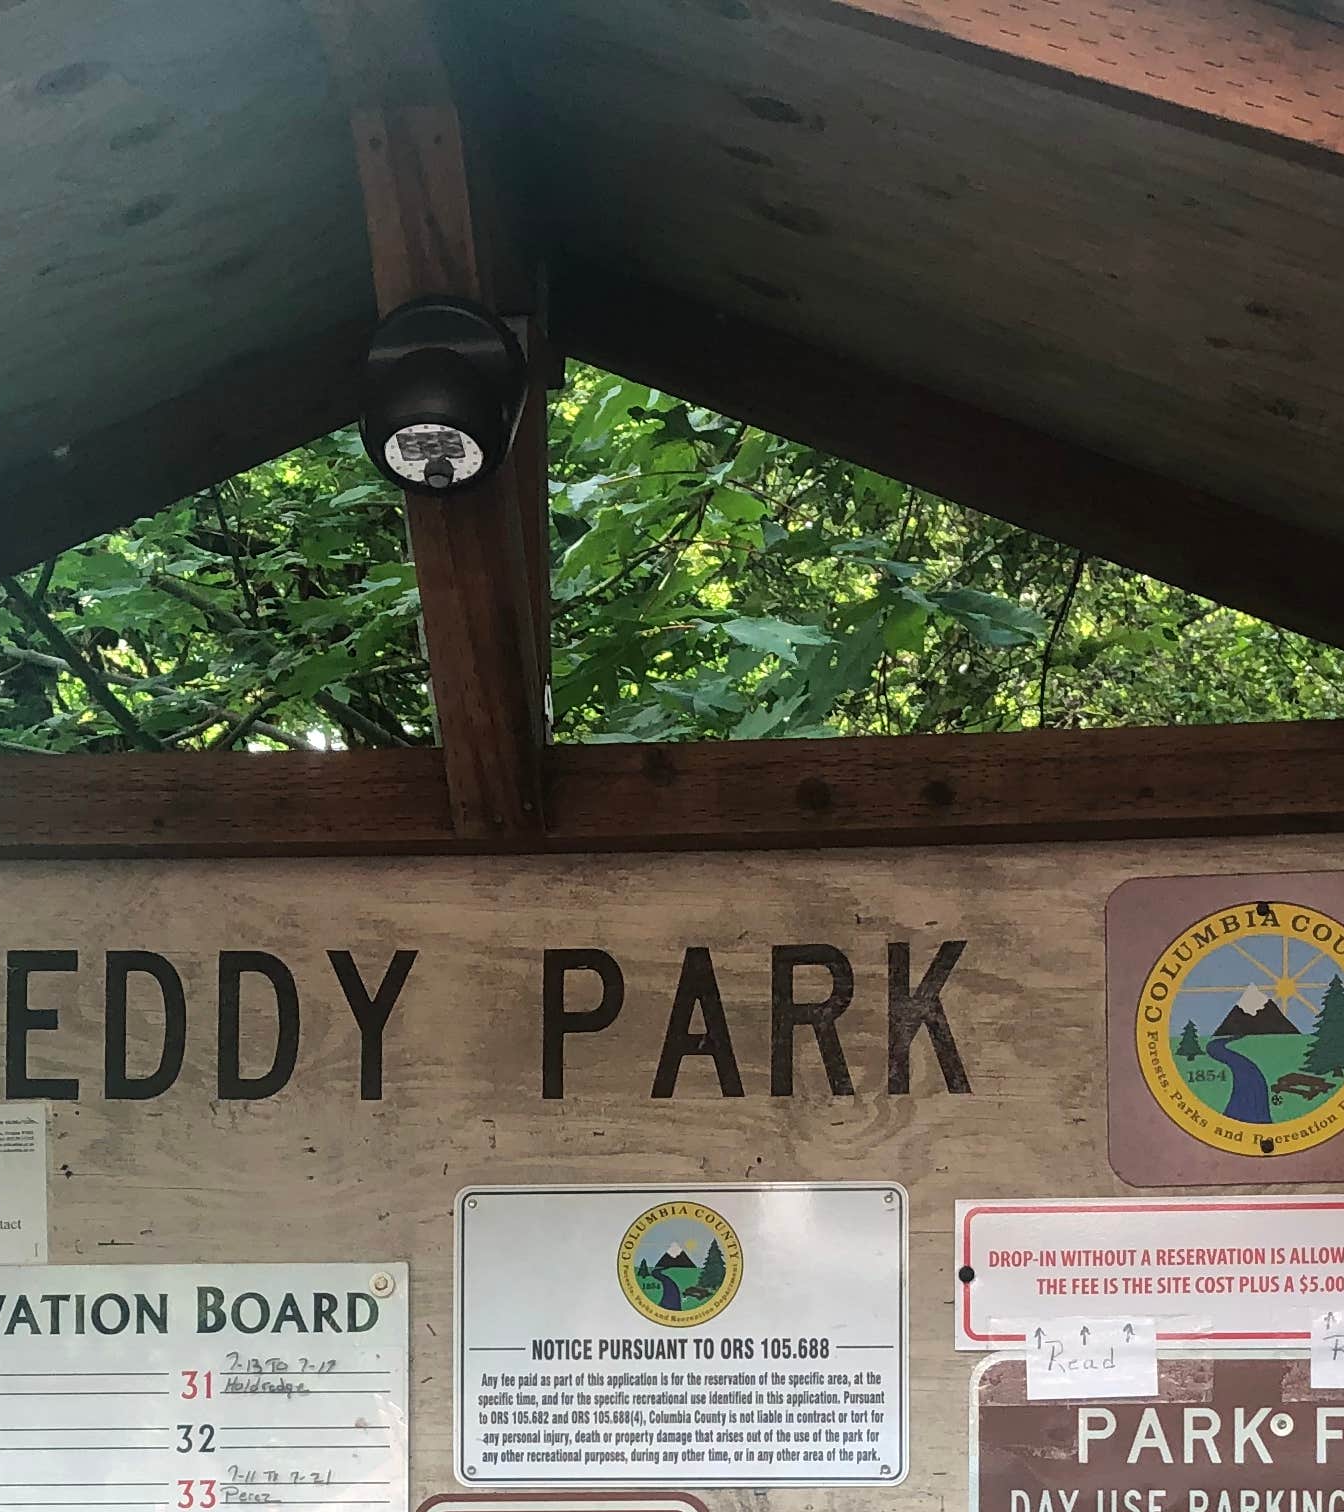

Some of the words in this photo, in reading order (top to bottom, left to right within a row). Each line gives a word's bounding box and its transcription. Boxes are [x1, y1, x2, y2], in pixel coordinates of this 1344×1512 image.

[1145, 910, 1280, 1024] COLUMBIA
[6, 949, 418, 1100] EDDY
[543, 940, 974, 1099] PARK
[1187, 1070, 1227, 1083] 1854
[1169, 1091, 1208, 1128] Parks
[1214, 1125, 1243, 1143] and
[989, 1250, 1057, 1268] DROP-IN
[1061, 1249, 1137, 1267] WITHOUT
[1141, 1249, 1152, 1266] A
[1157, 1247, 1265, 1266] RESERVATION
[1271, 1247, 1285, 1265] IS
[1037, 1277, 1067, 1295] THE
[1072, 1277, 1099, 1294] FEE
[1104, 1277, 1117, 1294] IS
[1122, 1277, 1153, 1294] THE
[1157, 1276, 1191, 1294] SITE
[1195, 1275, 1235, 1293] COST
[1239, 1275, 1279, 1293] PLUS
[1284, 1275, 1295, 1292] A
[1300, 1273, 1344, 1294] $5.00
[197, 1286, 379, 1334] BOARD
[532, 1339, 592, 1360] NOTICE
[599, 1339, 687, 1360] PURSUANT
[693, 1339, 714, 1359] TO
[721, 1338, 754, 1359] ORS
[761, 1338, 829, 1359] 105.688
[1045, 1340, 1117, 1372] Read
[181, 1371, 212, 1399] 31
[482, 1374, 497, 1388] Any
[501, 1374, 515, 1386] fee
[519, 1374, 537, 1388] paid
[541, 1376, 550, 1386] as
[554, 1374, 572, 1388] part
[576, 1373, 584, 1386] of
[588, 1373, 604, 1386] this
[607, 1373, 656, 1388] application
[661, 1373, 668, 1385] is
[671, 1372, 683, 1385] for
[687, 1373, 701, 1385] the
[706, 1372, 755, 1385] reservation
[759, 1372, 768, 1385] of
[772, 1373, 785, 1385] the
[789, 1372, 824, 1388] specific
[828, 1375, 851, 1386] area,
[854, 1373, 863, 1385] at
[867, 1372, 881, 1385] the
[176, 1425, 215, 1454] 32
[1078, 1408, 1276, 1464] PARK
[177, 1480, 217, 1509] 33
